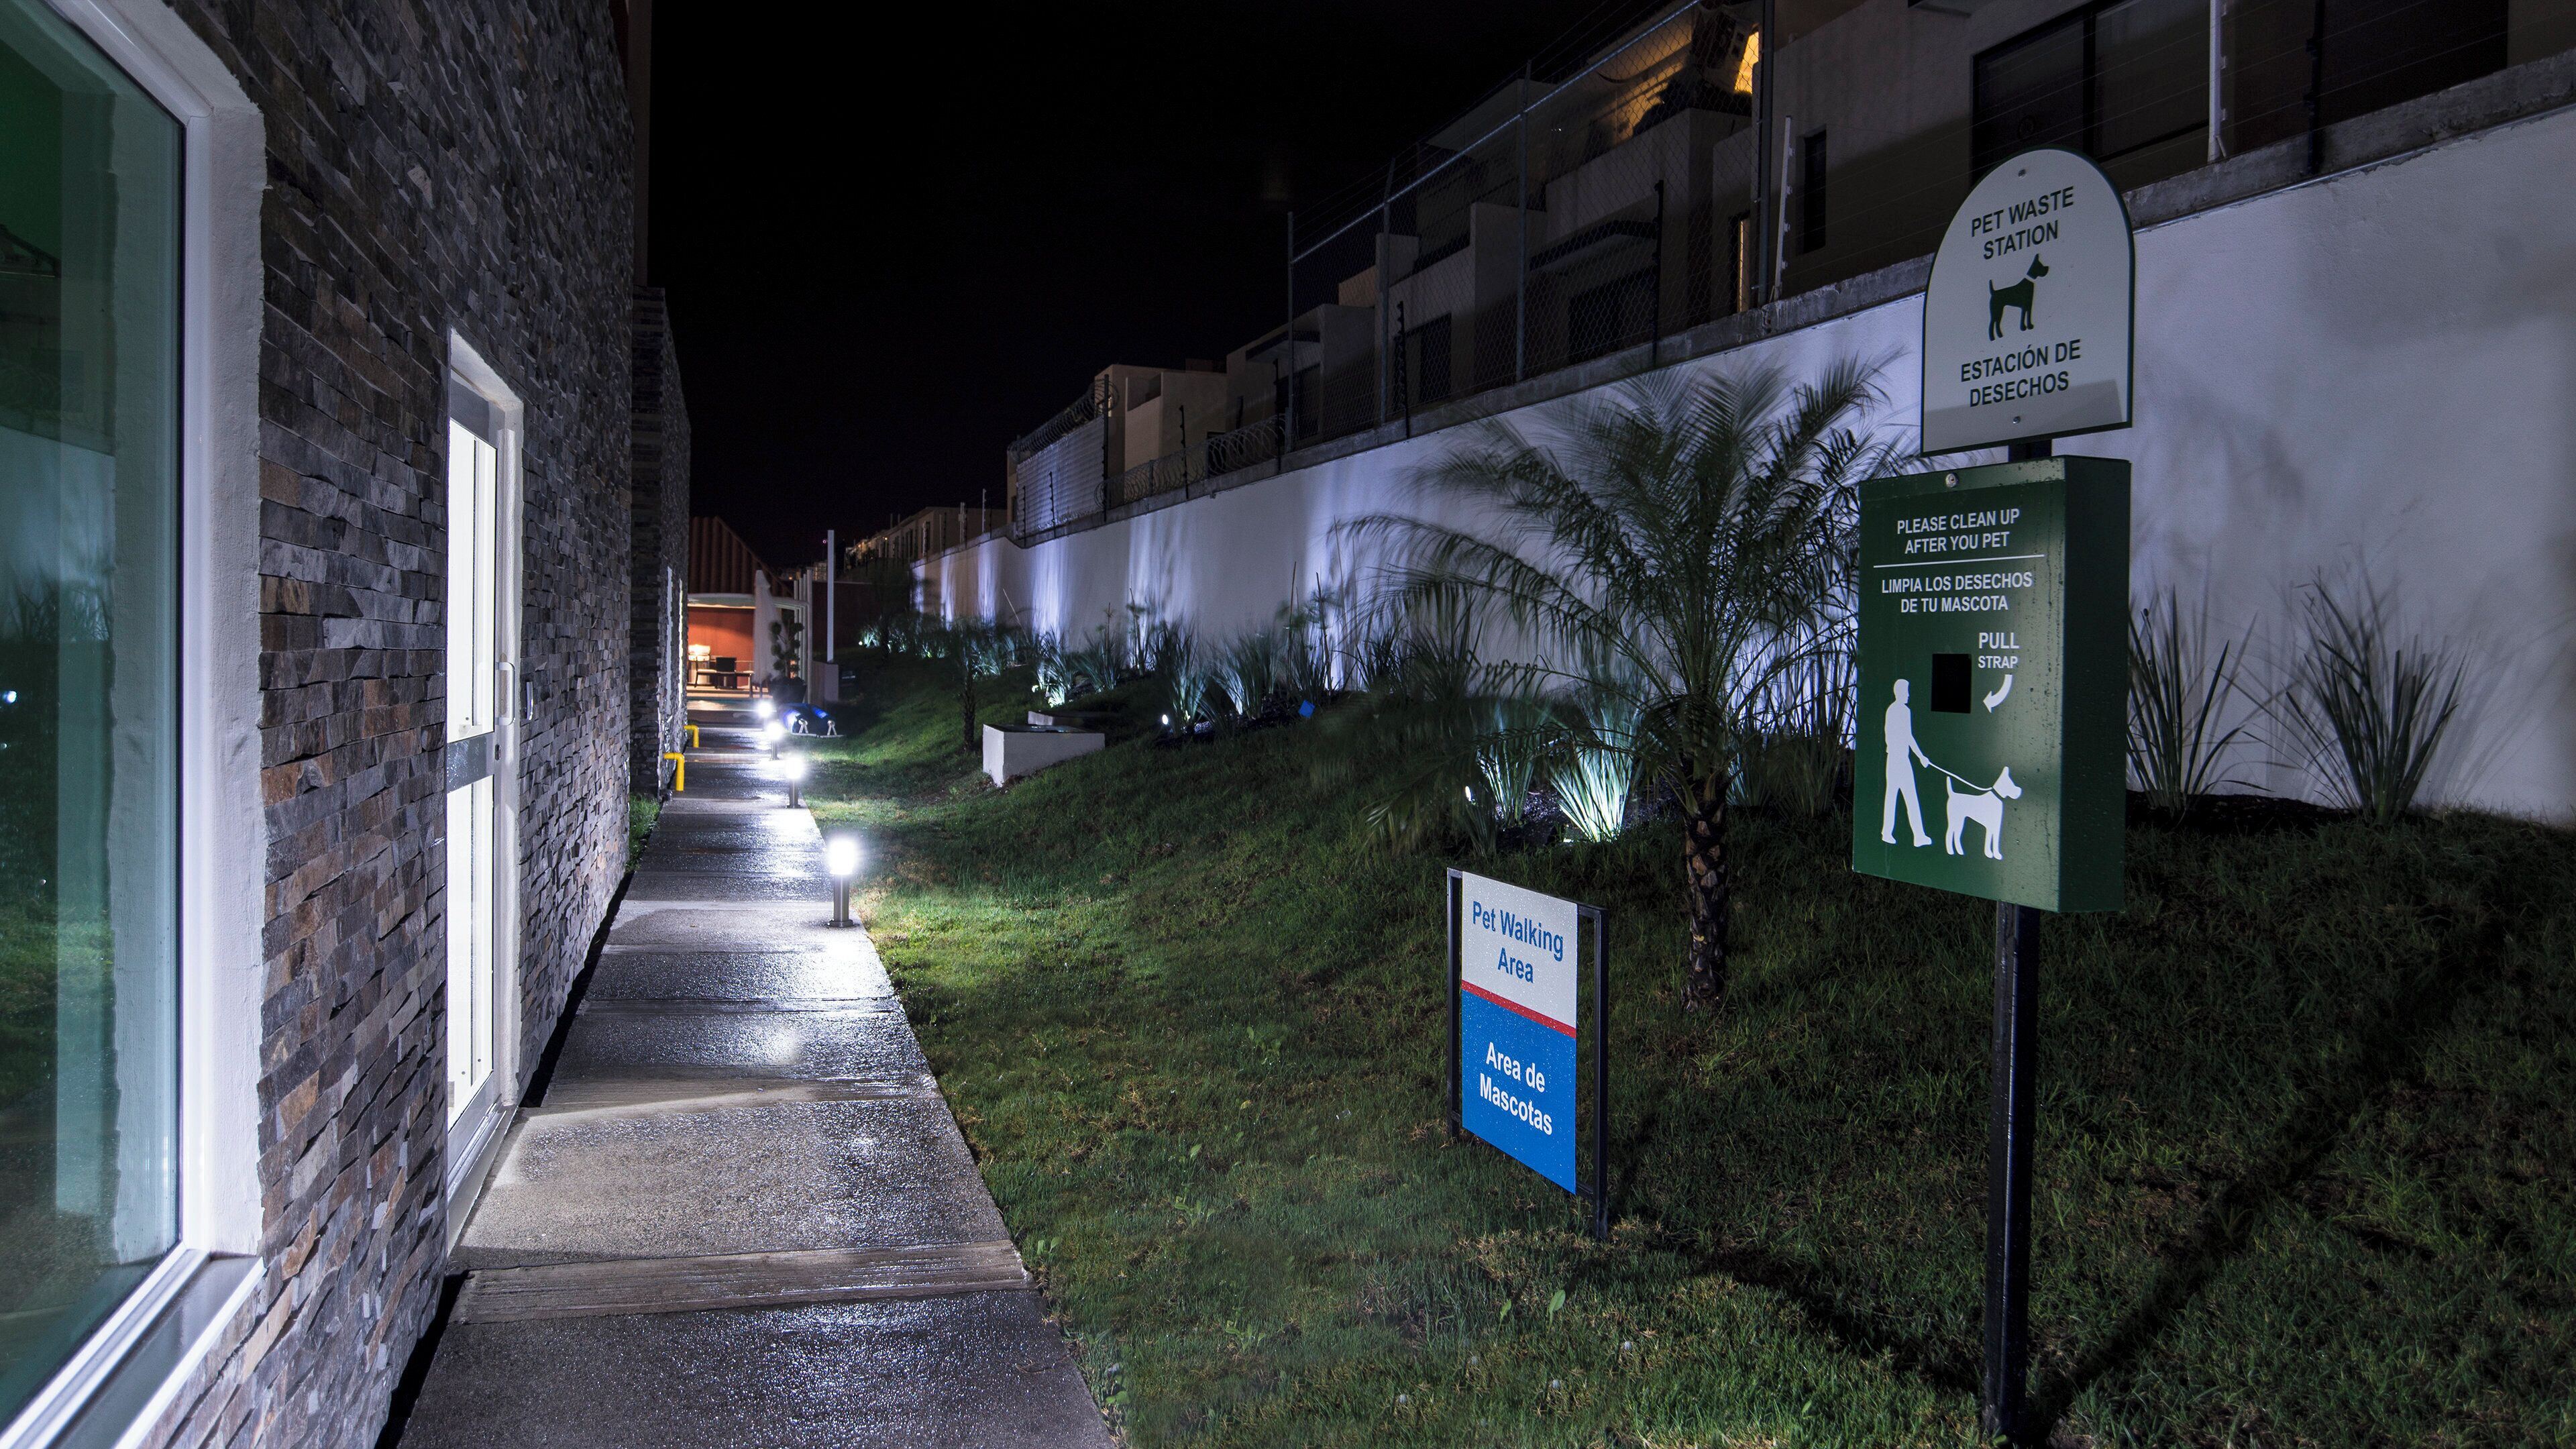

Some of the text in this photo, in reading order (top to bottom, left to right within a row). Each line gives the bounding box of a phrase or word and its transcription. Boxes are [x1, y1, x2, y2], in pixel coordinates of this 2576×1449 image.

[1971, 186, 2074, 237] PET WASTE
[1983, 220, 2059, 260] STATION
[1961, 339, 2081, 382] ESTACIÓN DE
[1970, 370, 2070, 408] DESECHOS
[1897, 508, 2020, 535] PLEASE CLEAN UP
[1904, 531, 2010, 554] AFTER YOU PET
[1882, 571, 2033, 594] LIMPIA LOS DESECHOS
[1900, 595, 2009, 613] DE TU MASCOTA
[1978, 632, 2019, 649] PULL
[1978, 655, 2019, 669] STRAP
[1472, 900, 1564, 962] Pet Walking
[1497, 947, 1534, 983] Area
[1485, 1042, 1546, 1093] Area de
[1479, 1073, 1553, 1136] Mascotas
